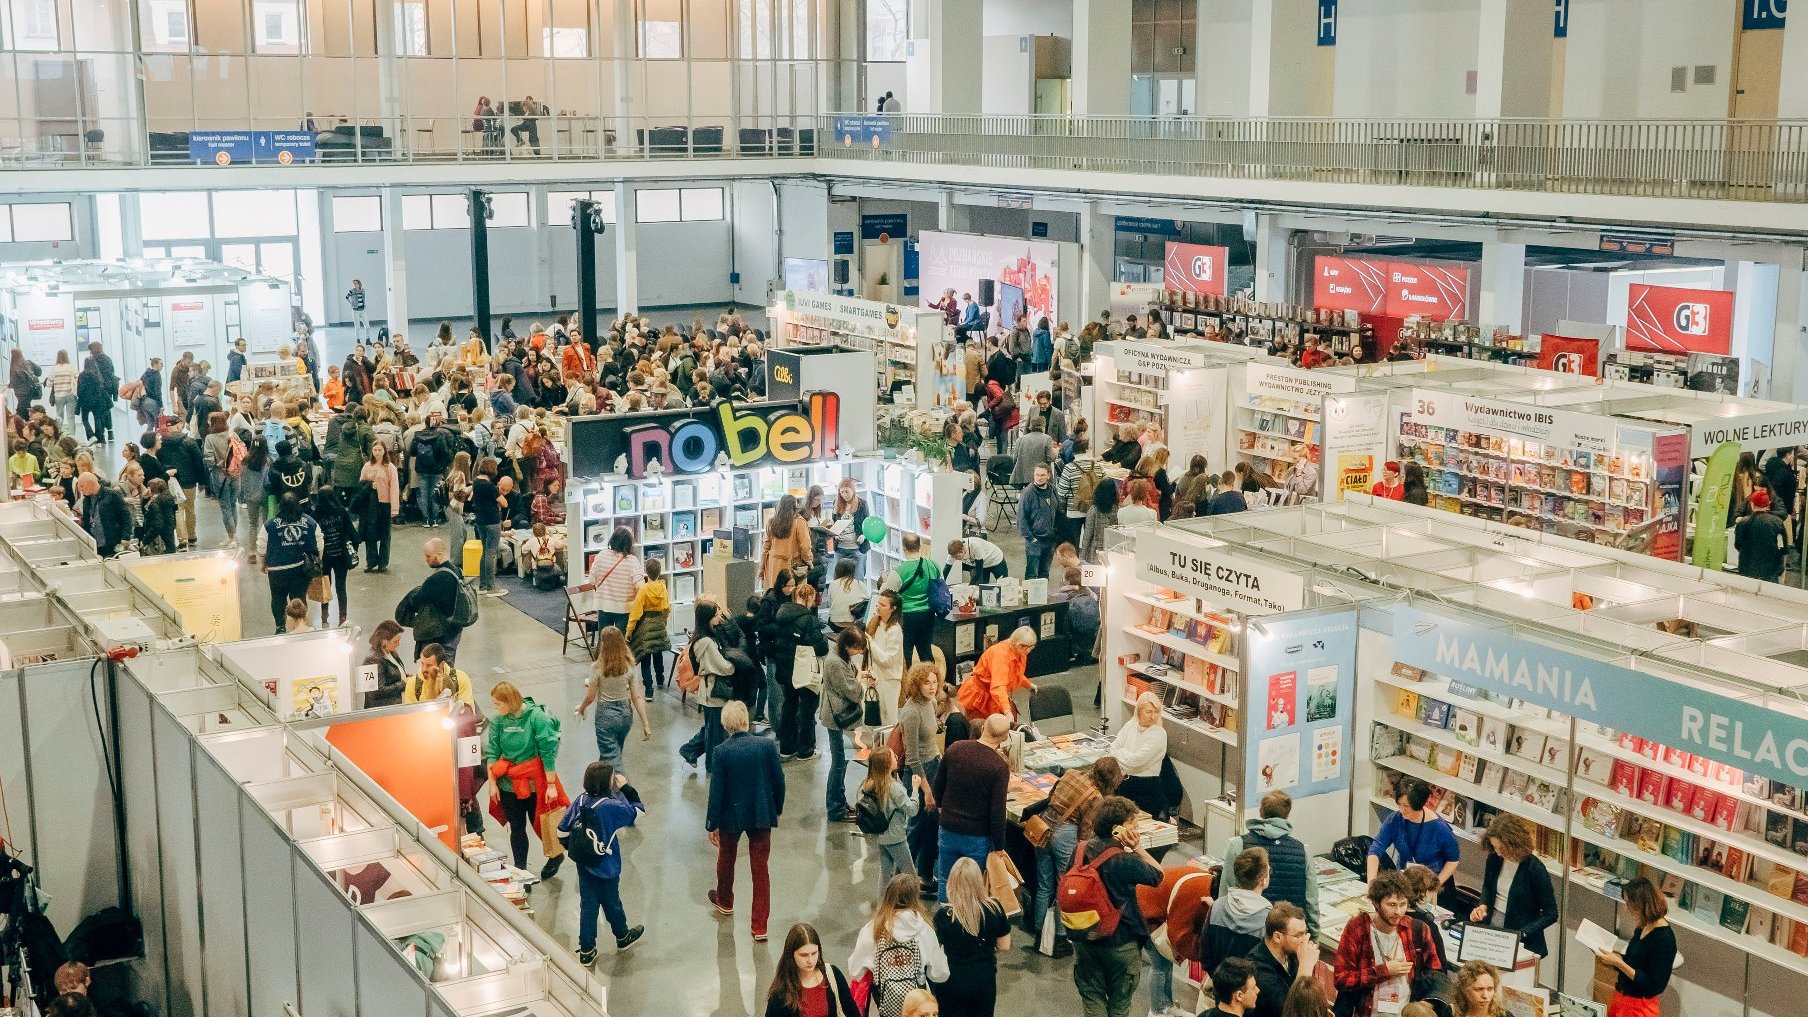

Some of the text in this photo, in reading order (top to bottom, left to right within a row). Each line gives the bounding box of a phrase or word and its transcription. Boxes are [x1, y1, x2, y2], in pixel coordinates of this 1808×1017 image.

[1320, 5, 1335, 38] H
[811, 300, 832, 311] GAMES
[839, 304, 883, 319] SMARTGAMES
[1674, 302, 1711, 336] G3
[1124, 348, 1192, 366] OFICYNA WYDAWNICZA
[1137, 360, 1150, 368] G&P
[1553, 352, 1583, 375] G3
[1259, 380, 1304, 394] WYDAWNICTWO
[1266, 373, 1332, 390] PRESTON PUBLISHING
[1417, 399, 1436, 417] 36
[1465, 402, 1554, 425] Wydawnictwo IBIS
[1704, 421, 1808, 446] WOLNE LEKTURY
[1345, 474, 1368, 485] CIAŁO
[1084, 570, 1094, 578] 20
[1169, 551, 1261, 592] TU SIĘ CZYTA
[1146, 562, 1285, 613] (Albus, Buka, Druganoga, Format, Tako)
[364, 671, 375, 681] 7A
[1435, 633, 1597, 712] MAMANIA
[1450, 681, 1477, 695] ROŚLINY
[471, 744, 478, 754] 8
[1681, 705, 1808, 778] RELAC
